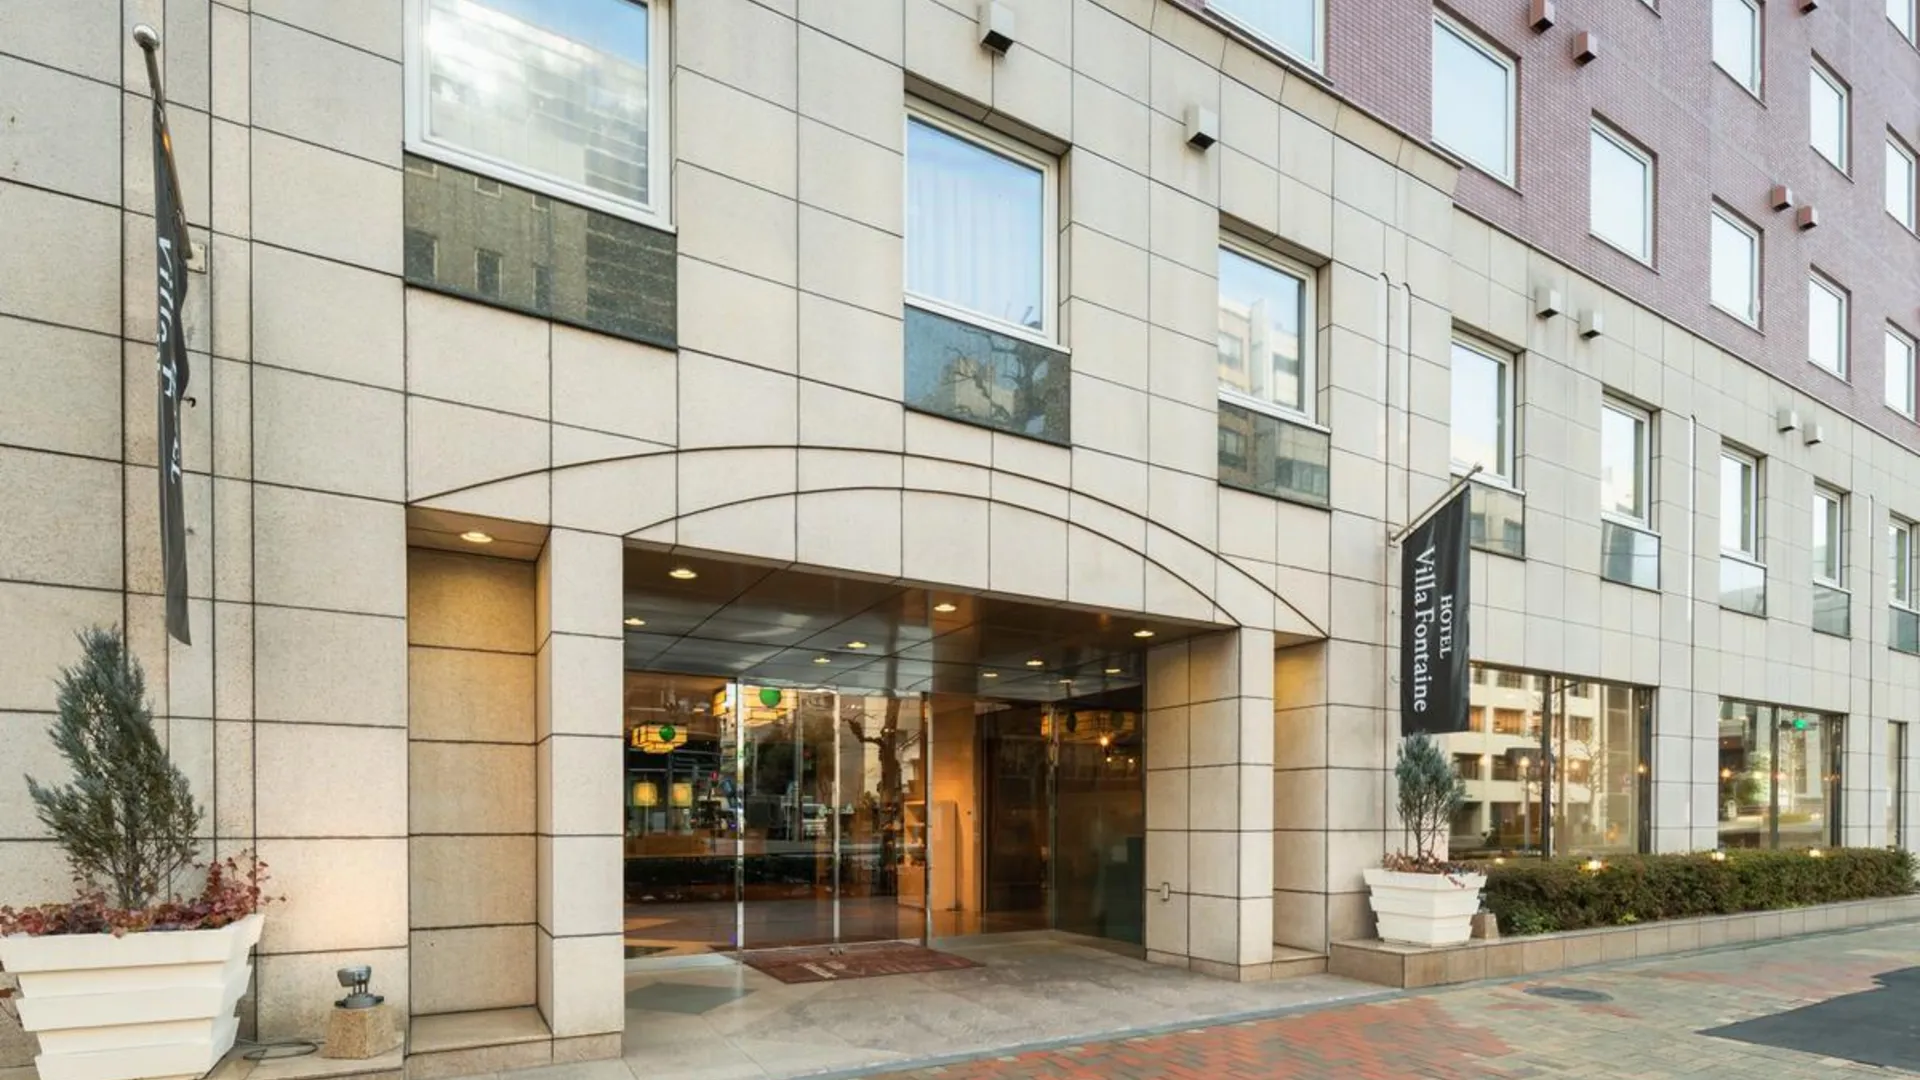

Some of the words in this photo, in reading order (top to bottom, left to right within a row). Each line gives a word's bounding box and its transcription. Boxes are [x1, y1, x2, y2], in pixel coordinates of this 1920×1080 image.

[1414, 545, 1436, 605] Villa
[1413, 606, 1435, 712] Fontaine
[1439, 594, 1453, 659] HOTEL
